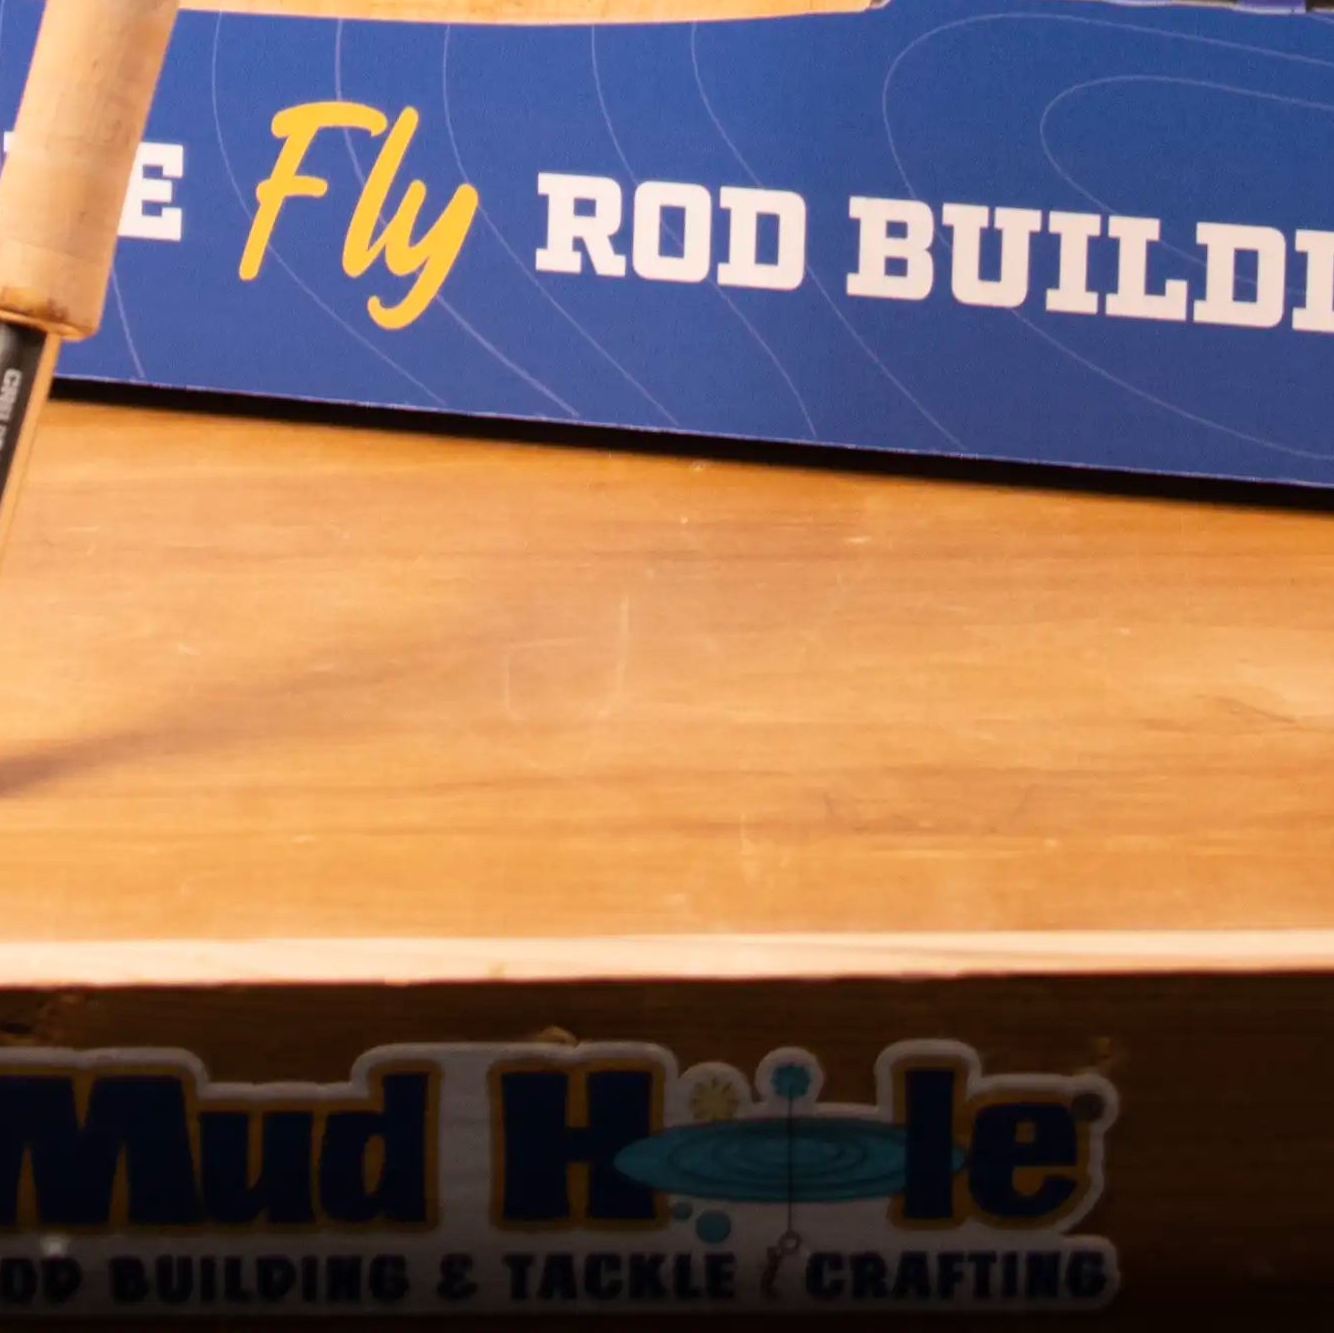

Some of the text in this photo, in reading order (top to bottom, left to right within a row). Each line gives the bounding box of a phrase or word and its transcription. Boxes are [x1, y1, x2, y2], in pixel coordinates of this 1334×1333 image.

[238, 100, 479, 331] Fly
[535, 171, 807, 292] ROD
[111, 1254, 408, 1303] BUILDING
[437, 1254, 479, 1302] &
[504, 1252, 737, 1302] TACKLE
[804, 1250, 1108, 1301] CRAFTING
